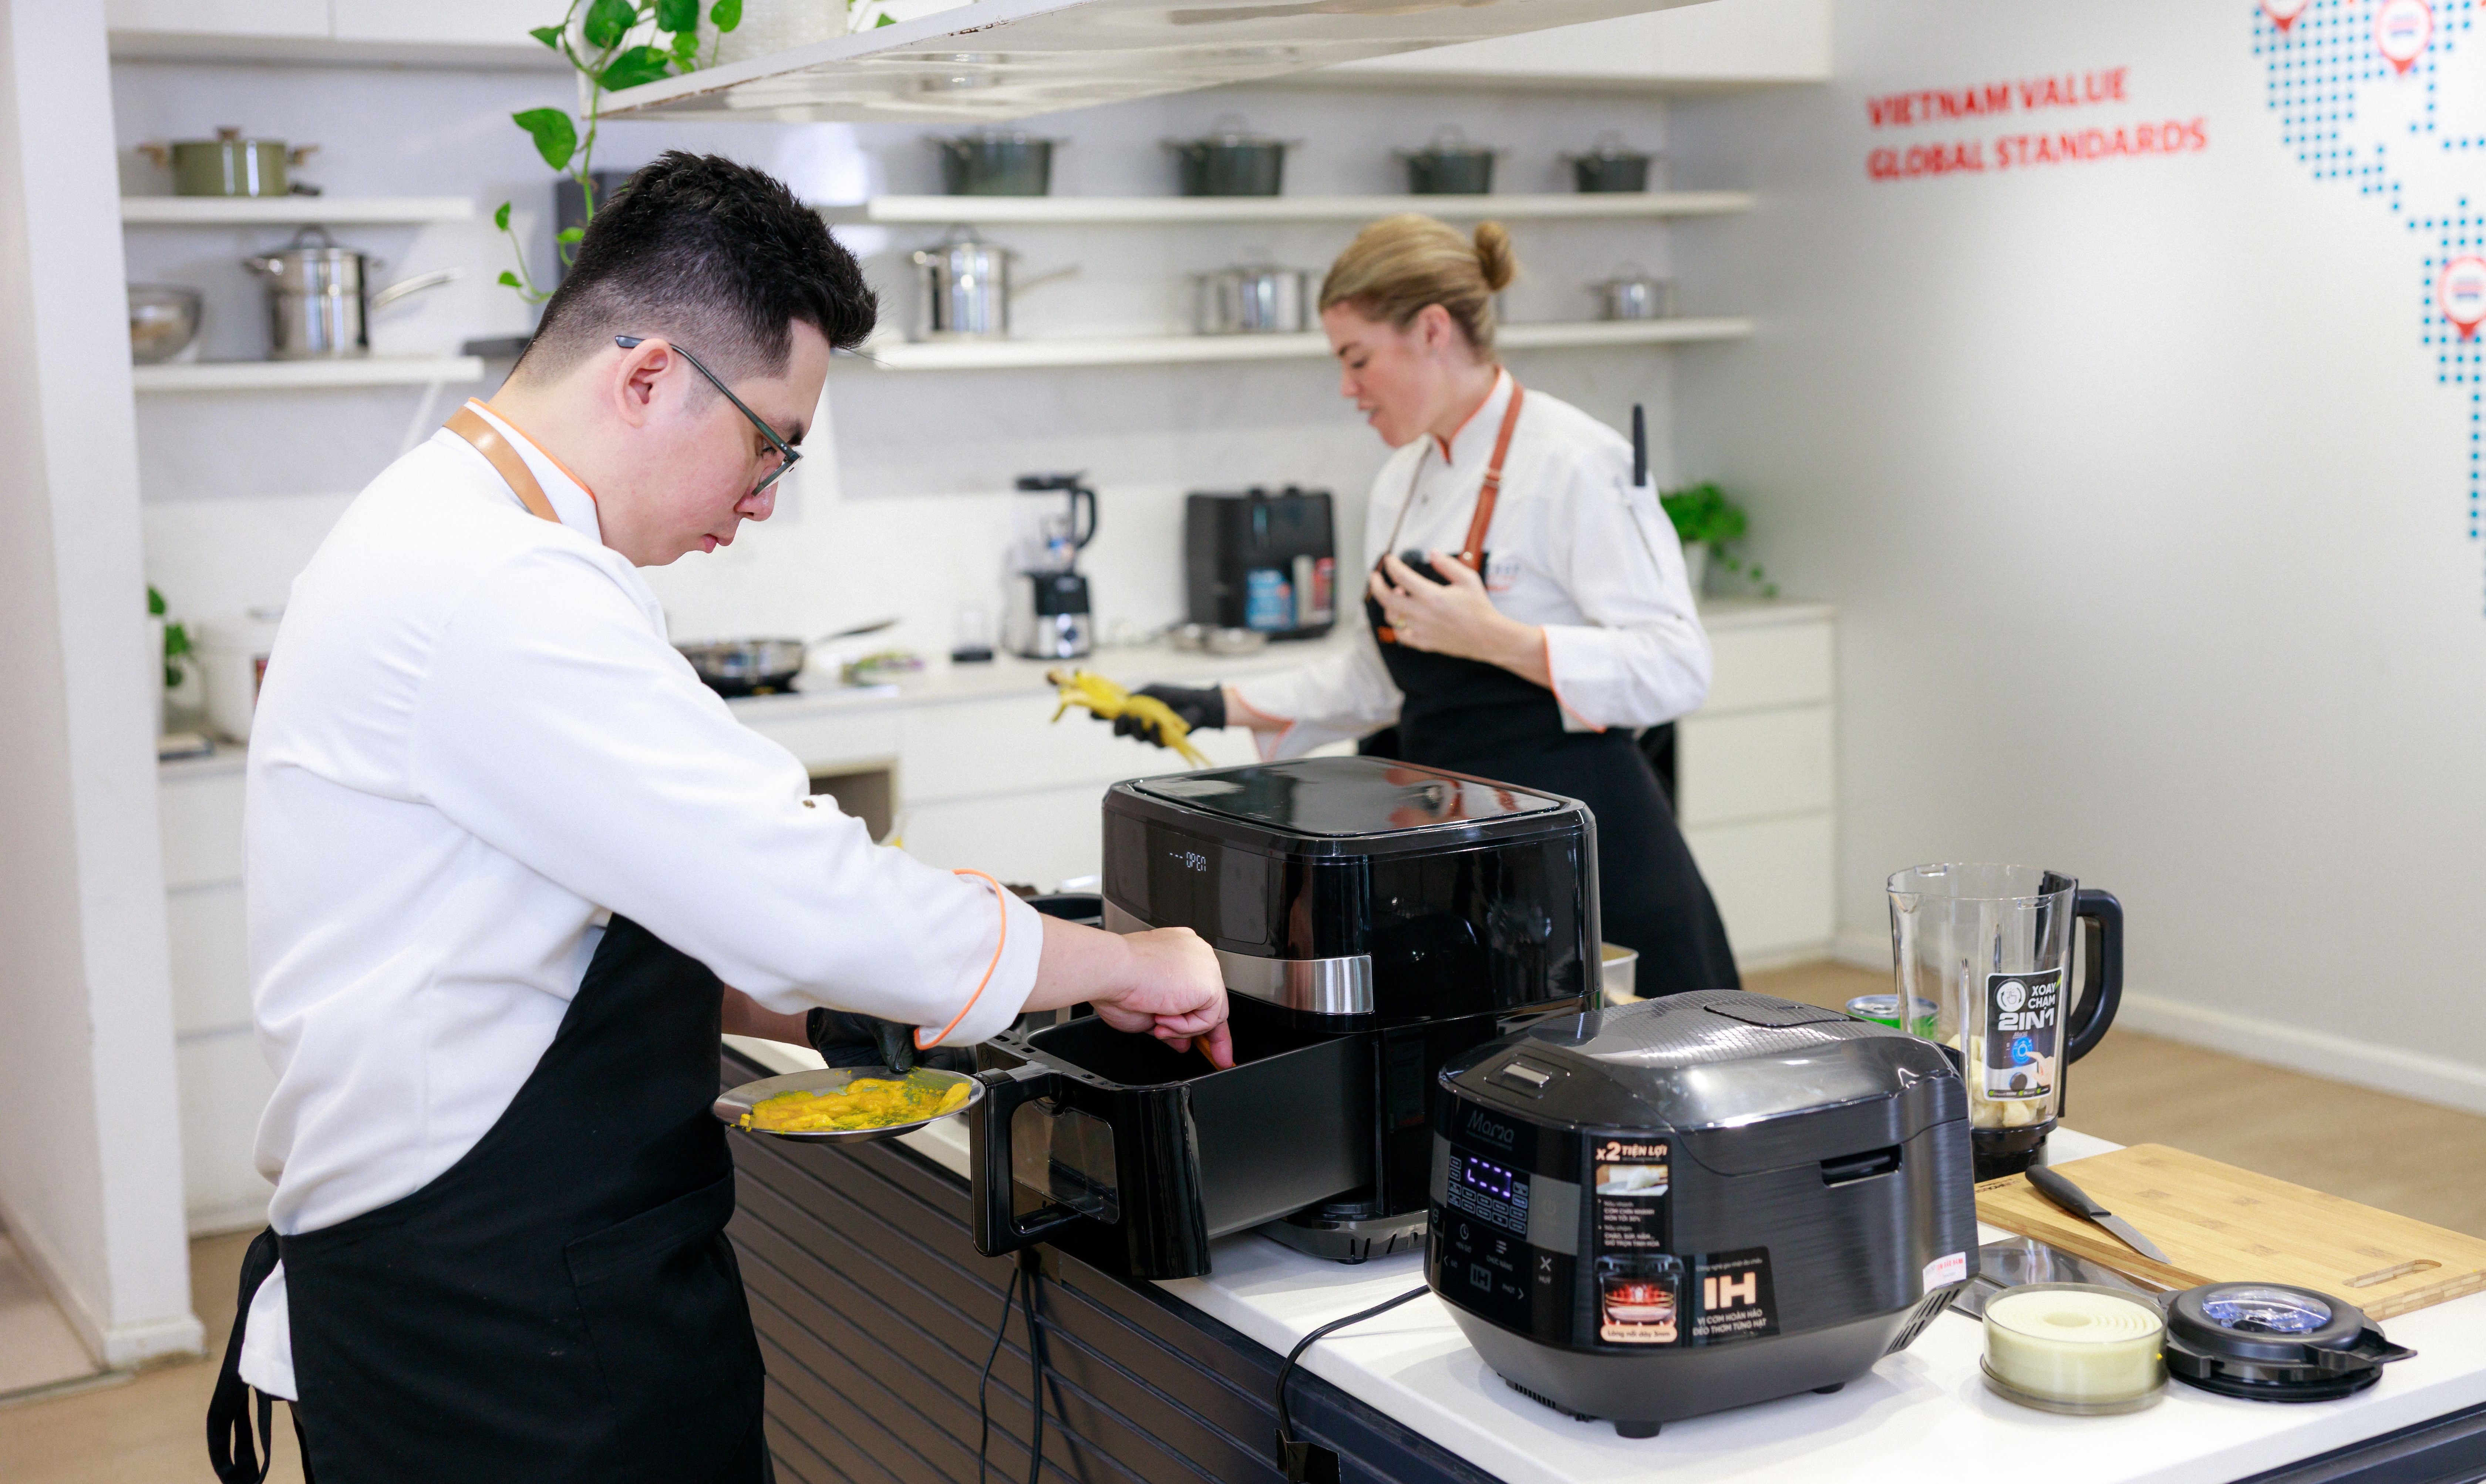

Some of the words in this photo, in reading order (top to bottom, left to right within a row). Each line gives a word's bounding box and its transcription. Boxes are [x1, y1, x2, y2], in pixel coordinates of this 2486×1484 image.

[1866, 82, 2011, 128] VIETNAM
[2019, 66, 2129, 110] VALUE
[1868, 142, 1985, 181] GLOBAL
[1997, 117, 2206, 171] STANDARDS
[2028, 994, 2055, 1010] CHẠM
[2031, 982, 2056, 996] XOAY
[1998, 1007, 2055, 1031] 2IN1
[1704, 1271, 1756, 1310] IH
